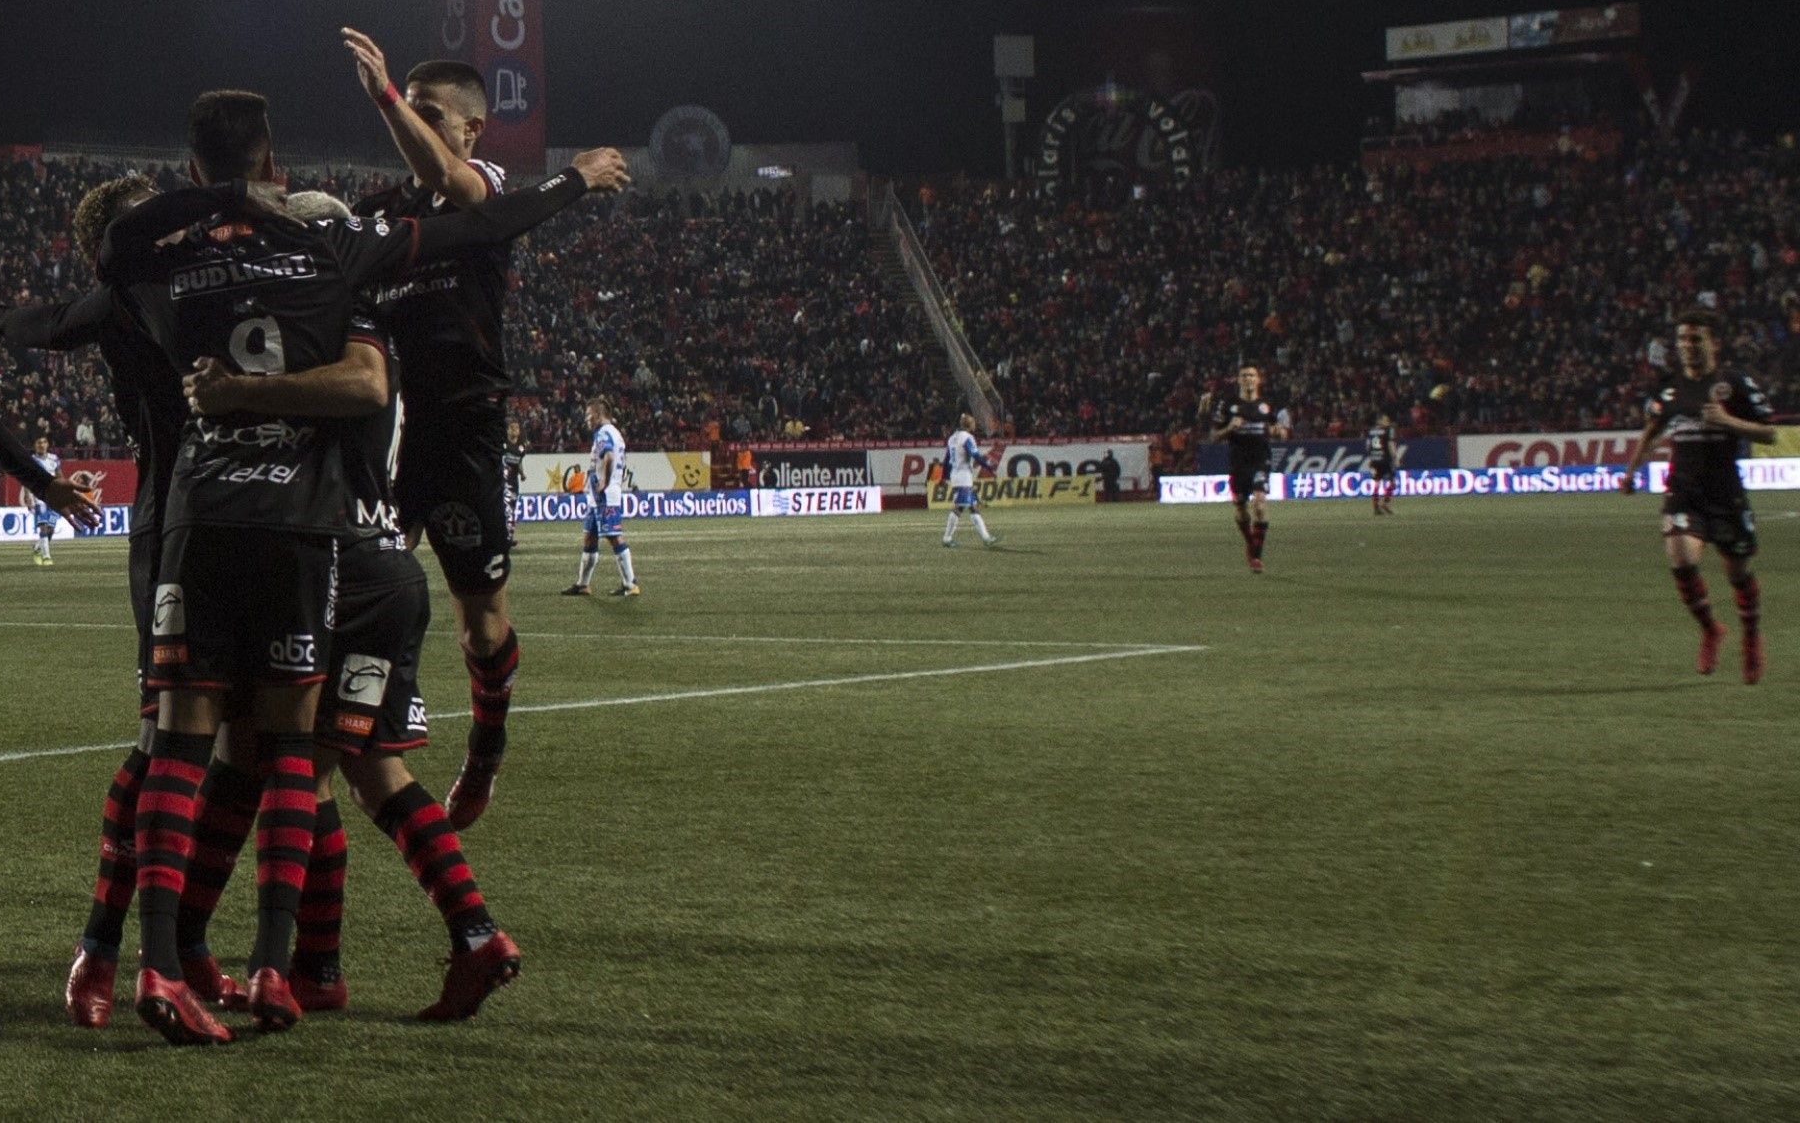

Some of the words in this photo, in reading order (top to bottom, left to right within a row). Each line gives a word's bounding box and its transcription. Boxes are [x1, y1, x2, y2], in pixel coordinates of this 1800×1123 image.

[173, 266, 228, 294] BUD
[228, 254, 307, 284] LIGHT
[931, 479, 1043, 504] BDAHL
[1291, 465, 1642, 499] #ElCohónDeTusSueñs
[791, 490, 868, 513] STEREN
